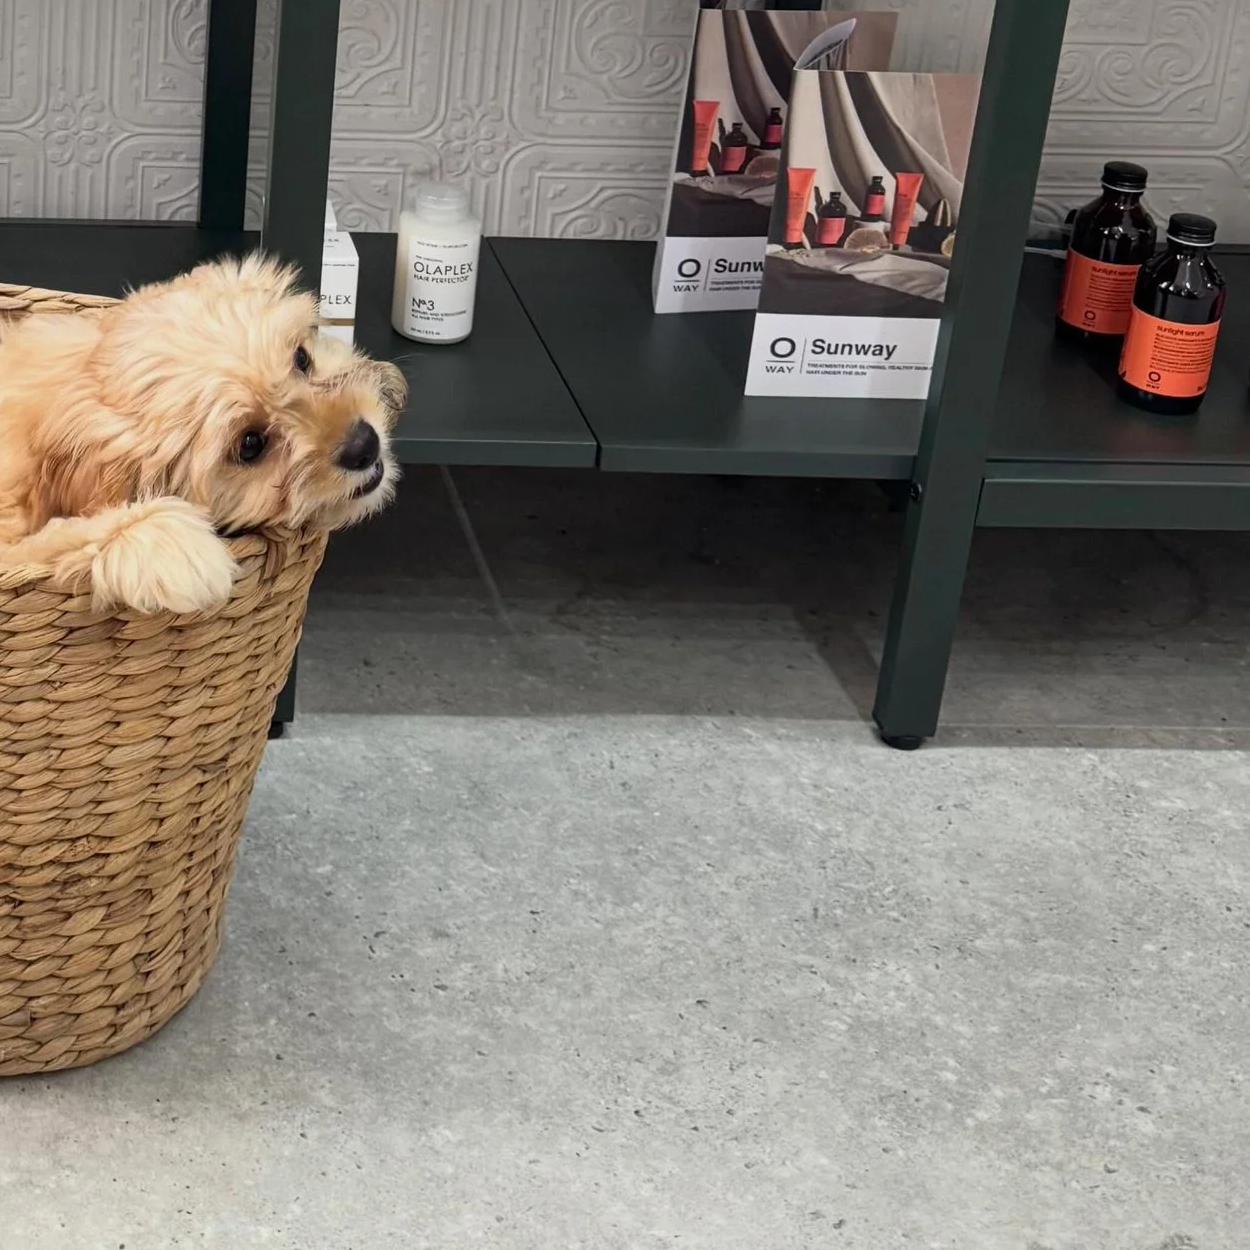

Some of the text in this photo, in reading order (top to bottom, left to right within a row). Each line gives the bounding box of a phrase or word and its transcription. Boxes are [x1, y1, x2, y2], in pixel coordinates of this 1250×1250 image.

[413, 261, 473, 276] OLAPLEX
[677, 258, 701, 278] O
[714, 258, 765, 274] Sunw
[413, 273, 430, 282] HAIR
[672, 284, 699, 292] WAY
[320, 294, 352, 305] PLEX
[1084, 310, 1096, 320] O
[1157, 325, 1184, 336] sunlight
[769, 336, 797, 359] O
[810, 338, 898, 361] Sunway
[765, 365, 794, 374] WAY
[1148, 371, 1161, 382] O
